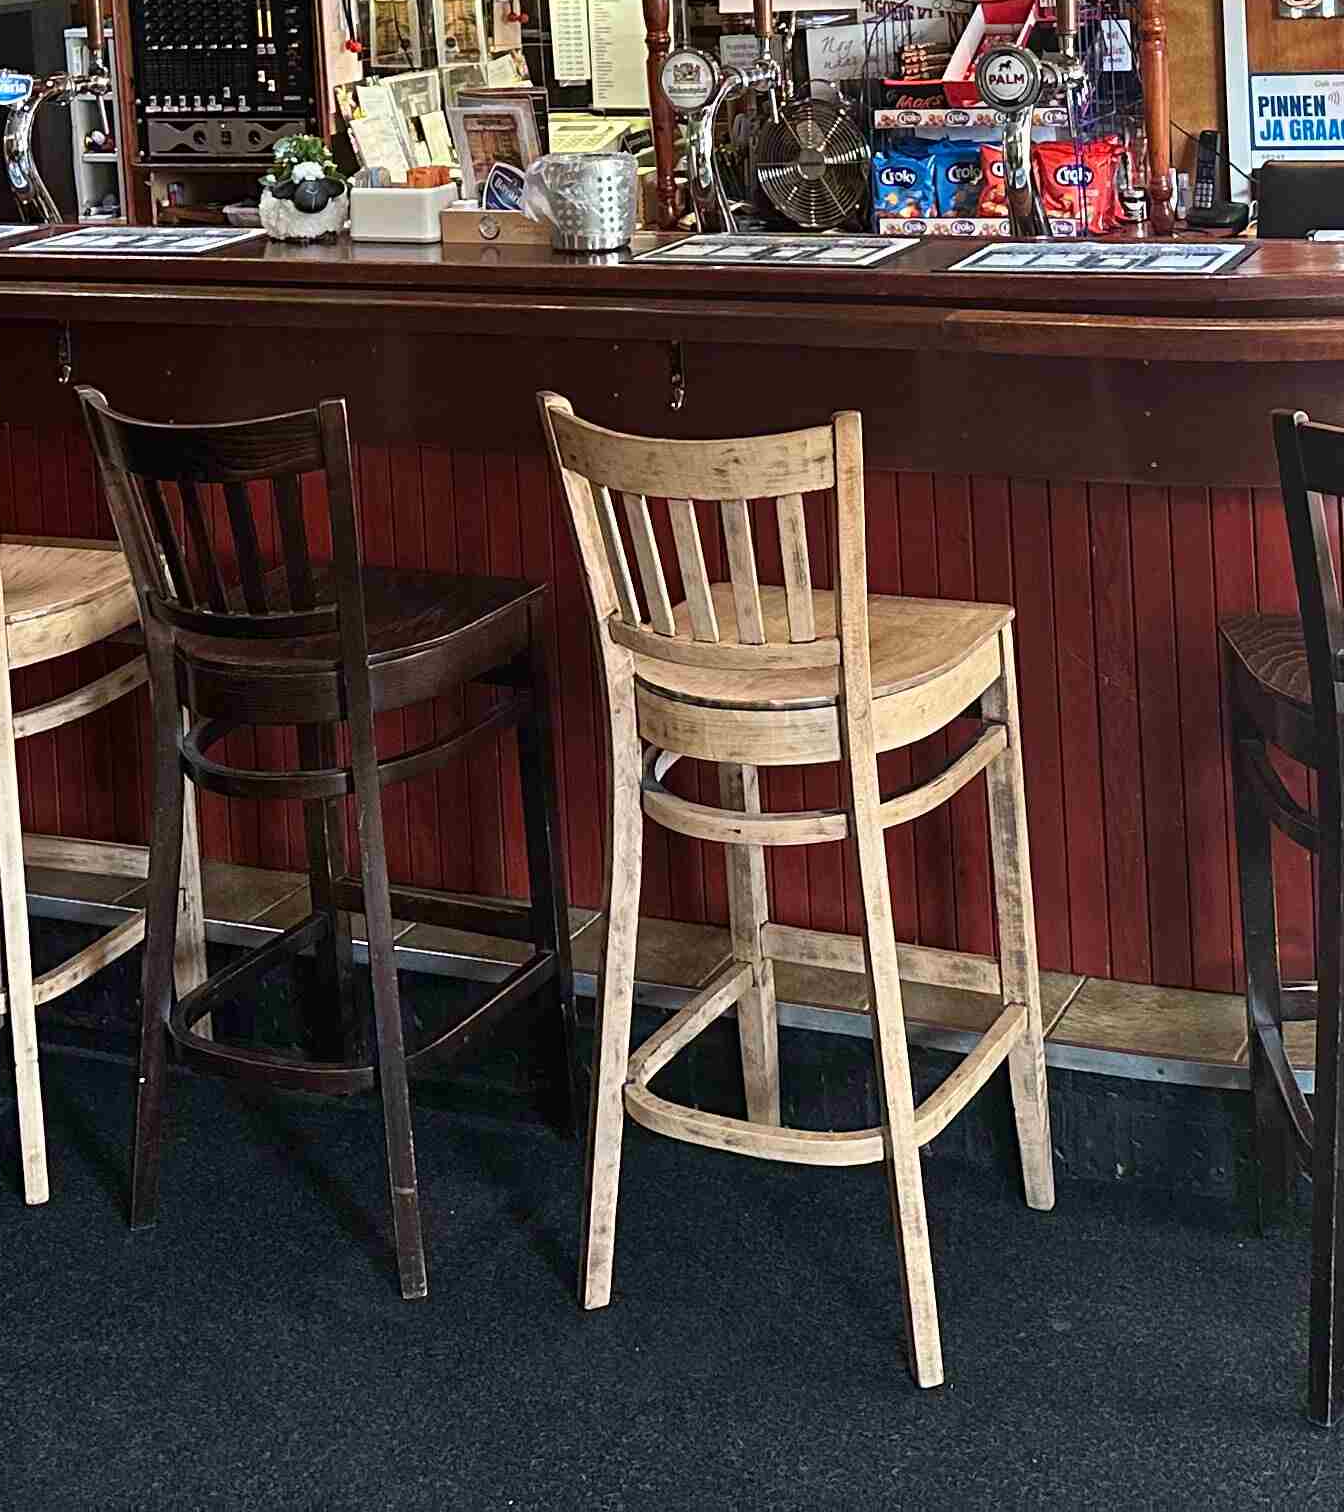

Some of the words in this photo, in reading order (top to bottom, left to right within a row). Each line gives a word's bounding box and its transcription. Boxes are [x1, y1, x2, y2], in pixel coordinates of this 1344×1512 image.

[989, 73, 1025, 85] PALM
[1258, 94, 1327, 117] PINNEN
[1260, 118, 1285, 141] JA
[881, 168, 917, 186] Croky
